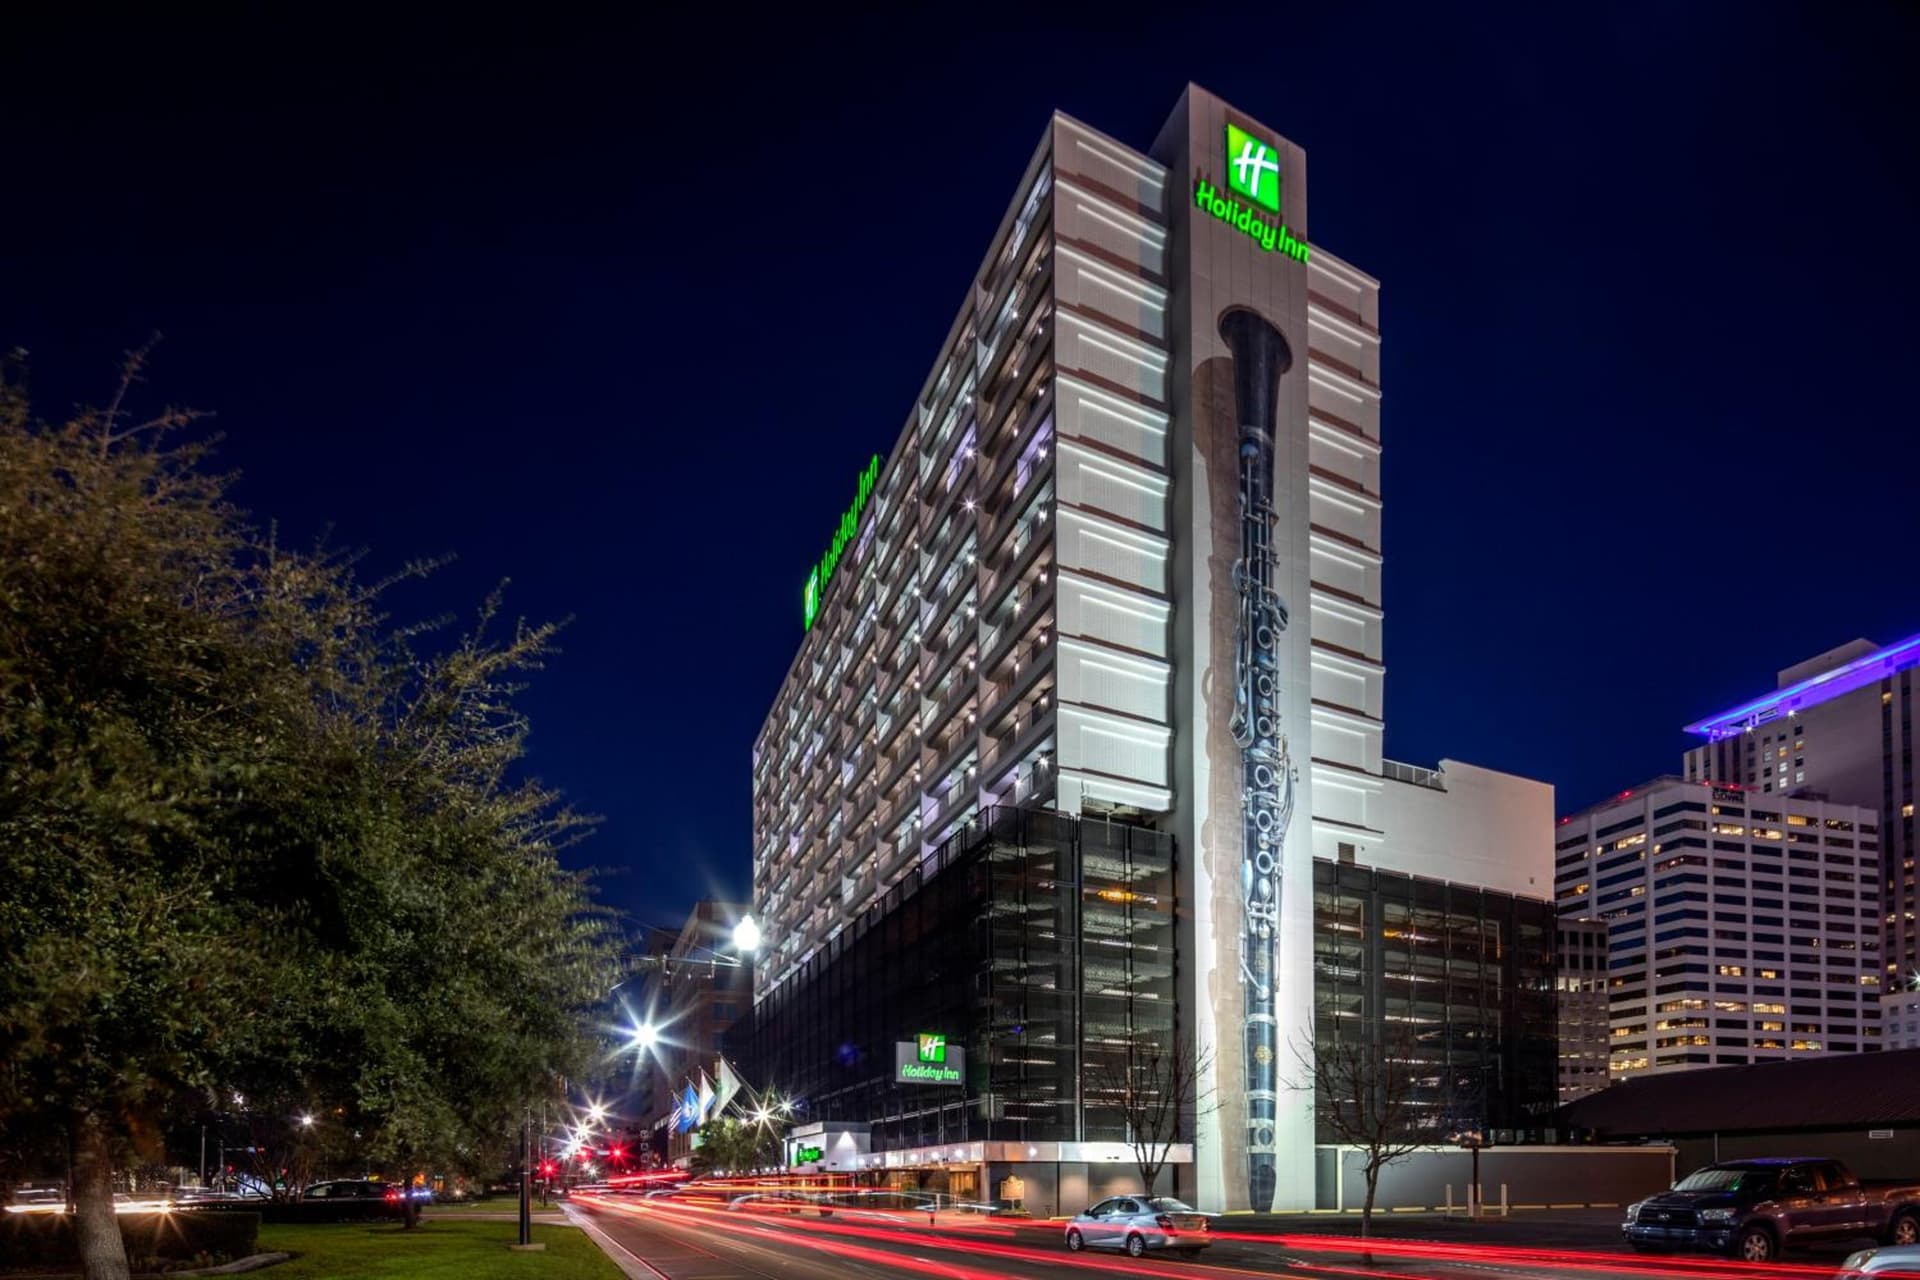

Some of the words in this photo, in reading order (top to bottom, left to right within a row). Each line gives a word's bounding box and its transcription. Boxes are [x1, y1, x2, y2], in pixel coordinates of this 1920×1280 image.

[1196, 180, 1277, 250] Holiday
[1277, 223, 1310, 264] Inn
[902, 1064, 943, 1081] Holiday
[944, 1066, 959, 1080] Inn
